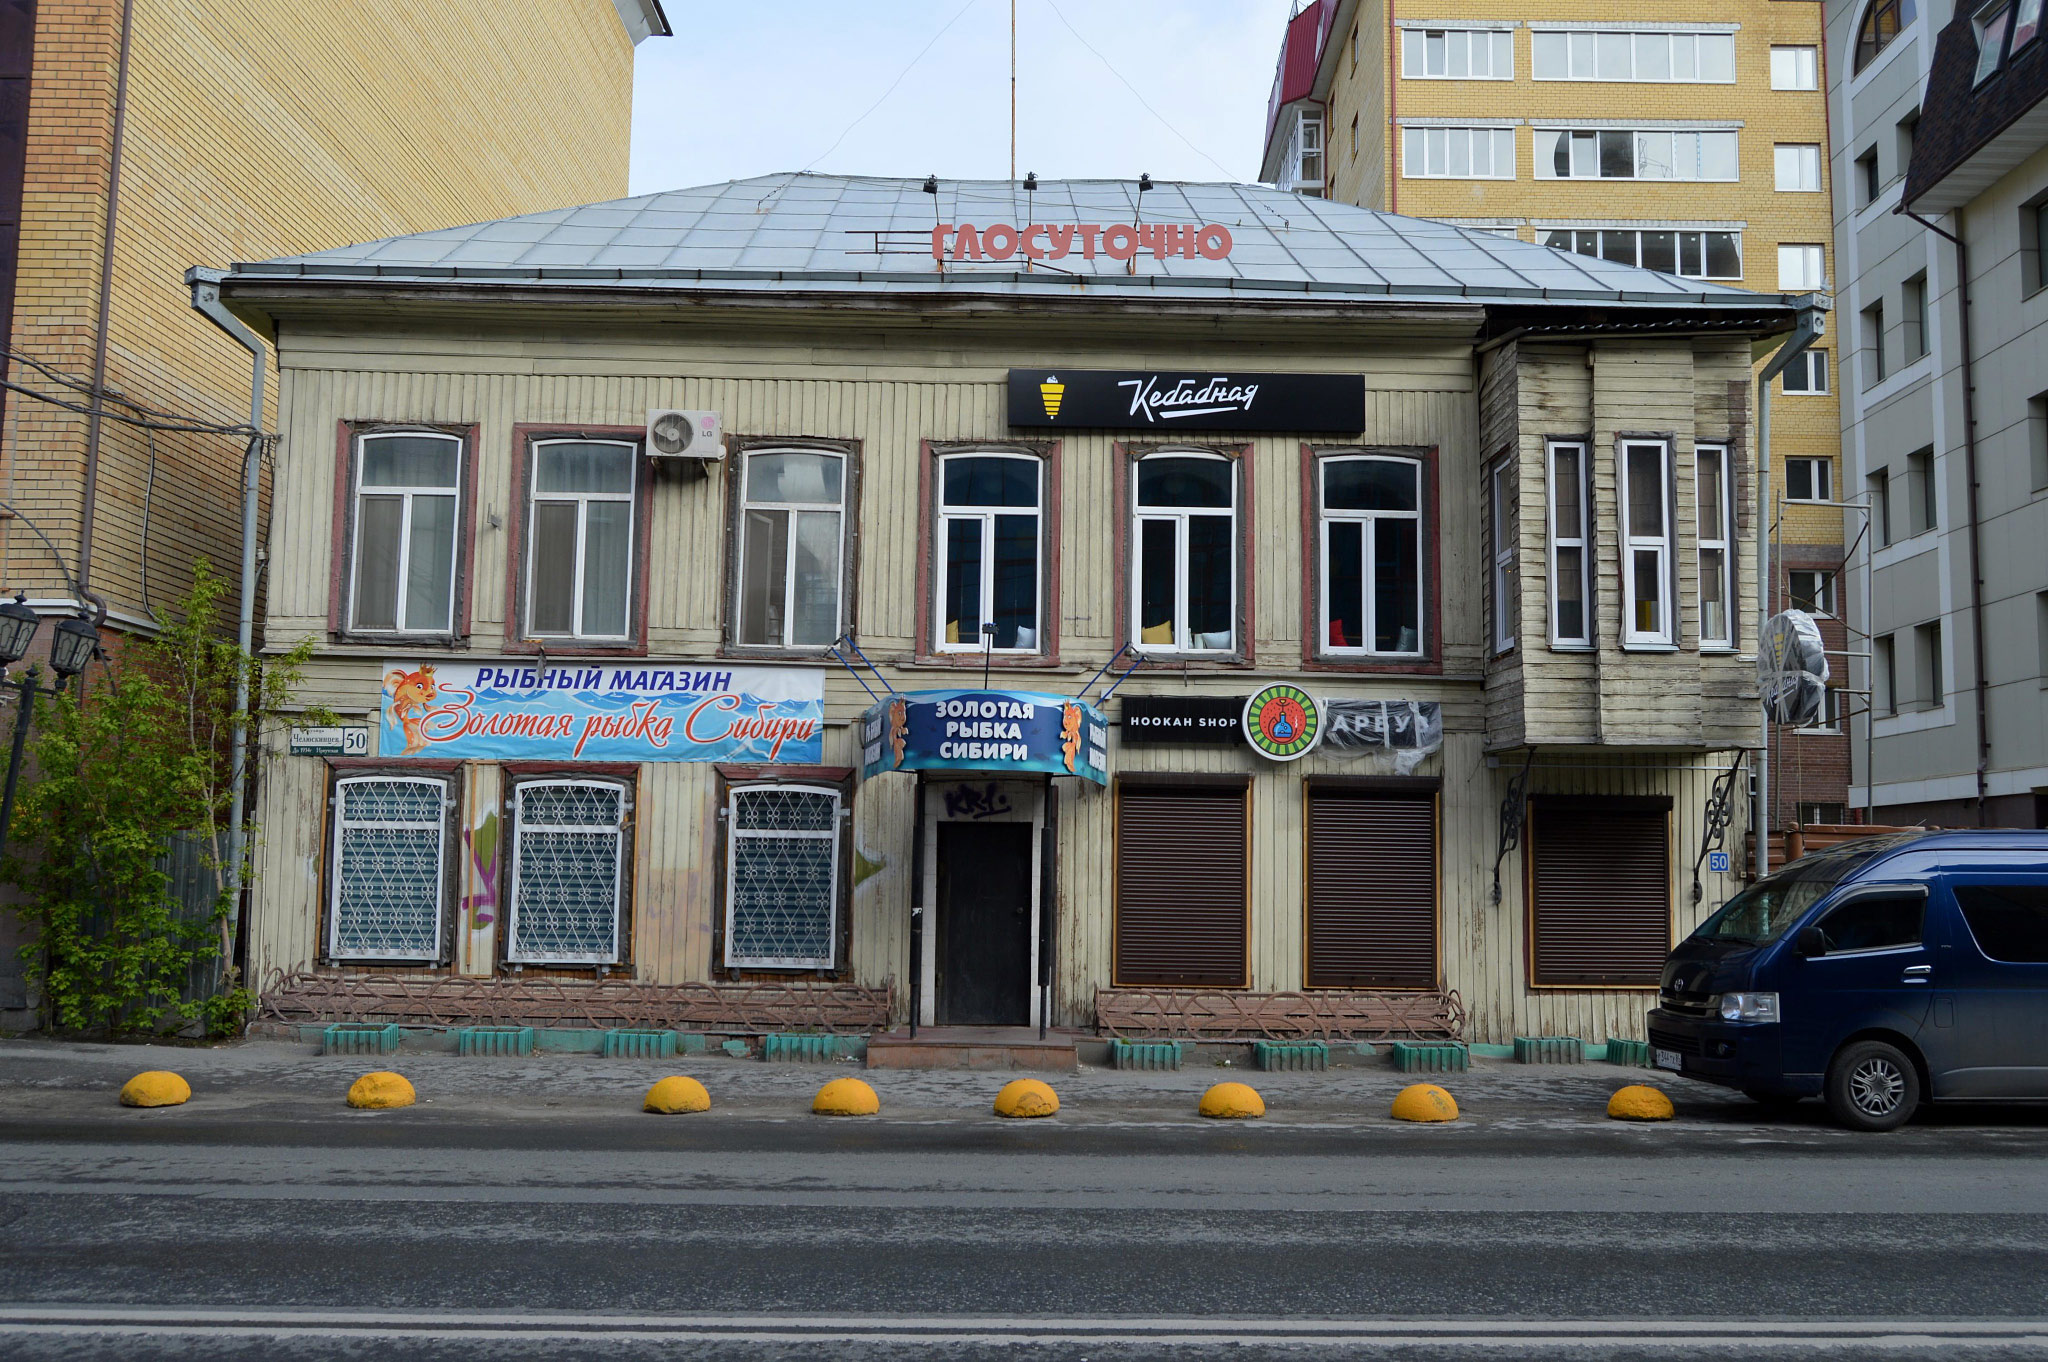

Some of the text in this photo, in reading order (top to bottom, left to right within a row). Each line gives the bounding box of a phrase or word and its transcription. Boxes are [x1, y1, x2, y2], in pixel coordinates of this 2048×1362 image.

[931, 223, 1233, 260] ГЛОСУТОЧНО
[1118, 375, 1258, 422] Кебабная
[475, 664, 732, 692] РЫБНЫЙ МАГАЗИН
[935, 700, 1034, 720] ЗОЛОТАЯ
[421, 683, 574, 742] Золотая
[573, 700, 673, 758] рыбка
[685, 694, 817, 760] Сибири
[946, 721, 1022, 739] РЫБКА
[1131, 716, 1238, 728] HOOKAH SHOP
[346, 732, 366, 749] 50
[939, 741, 1028, 761] СИБИРИ
[1711, 855, 1727, 869] 50
